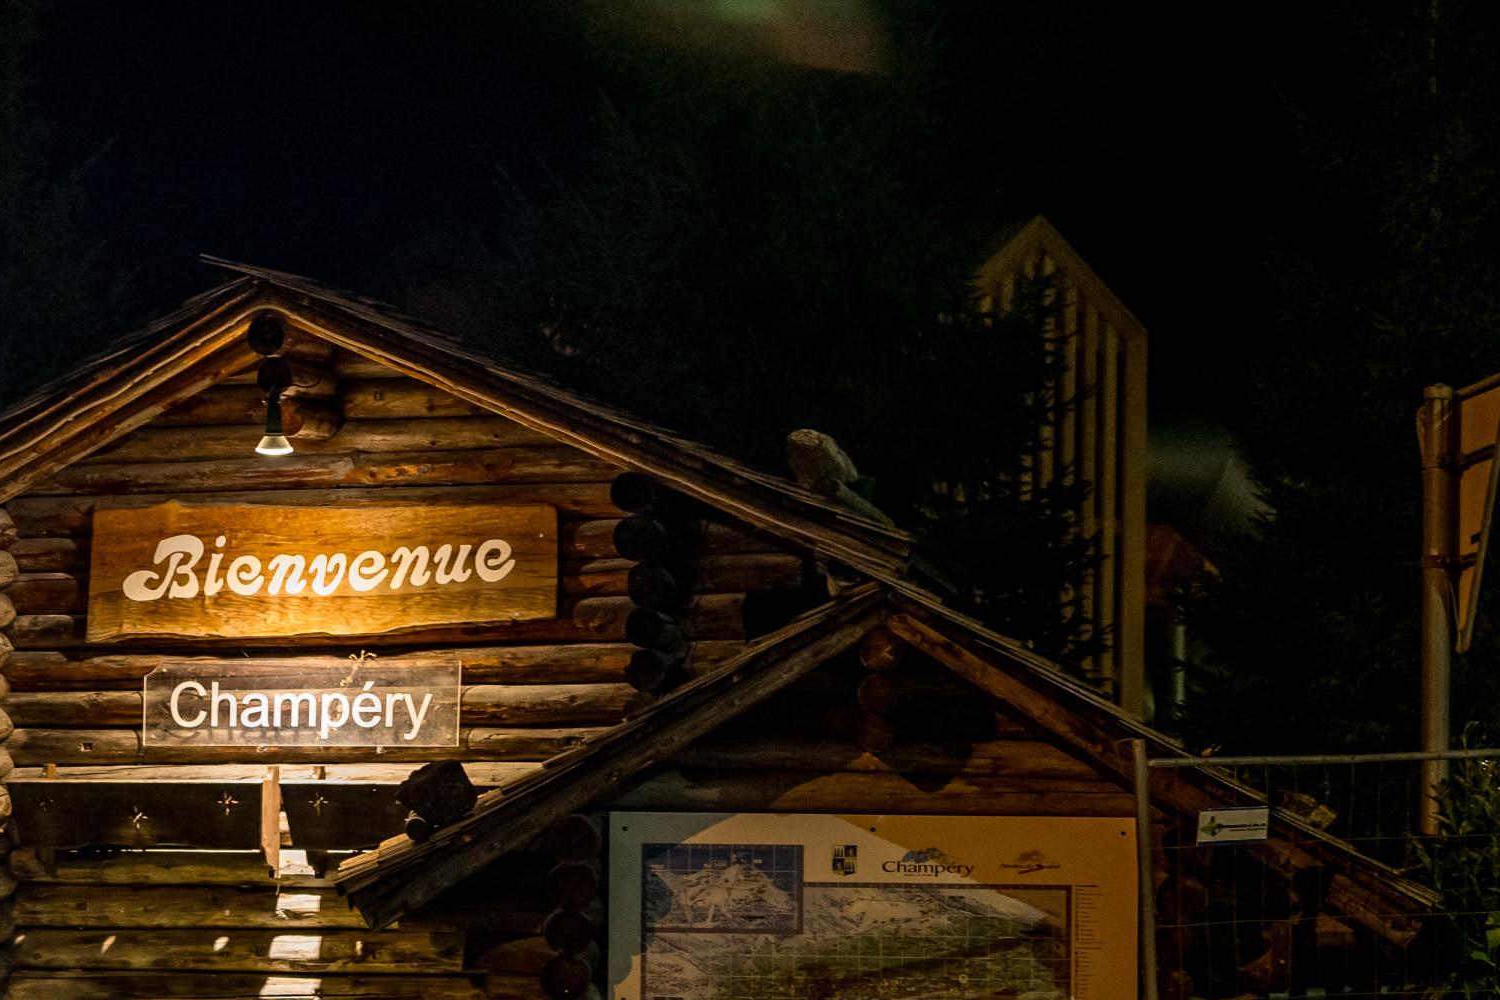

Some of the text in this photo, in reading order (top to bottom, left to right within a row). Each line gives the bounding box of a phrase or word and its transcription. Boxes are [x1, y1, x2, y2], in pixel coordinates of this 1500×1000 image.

[122, 534, 516, 602] Bienvenue
[169, 680, 433, 740] Champéry
[882, 861, 975, 878] Champéry
